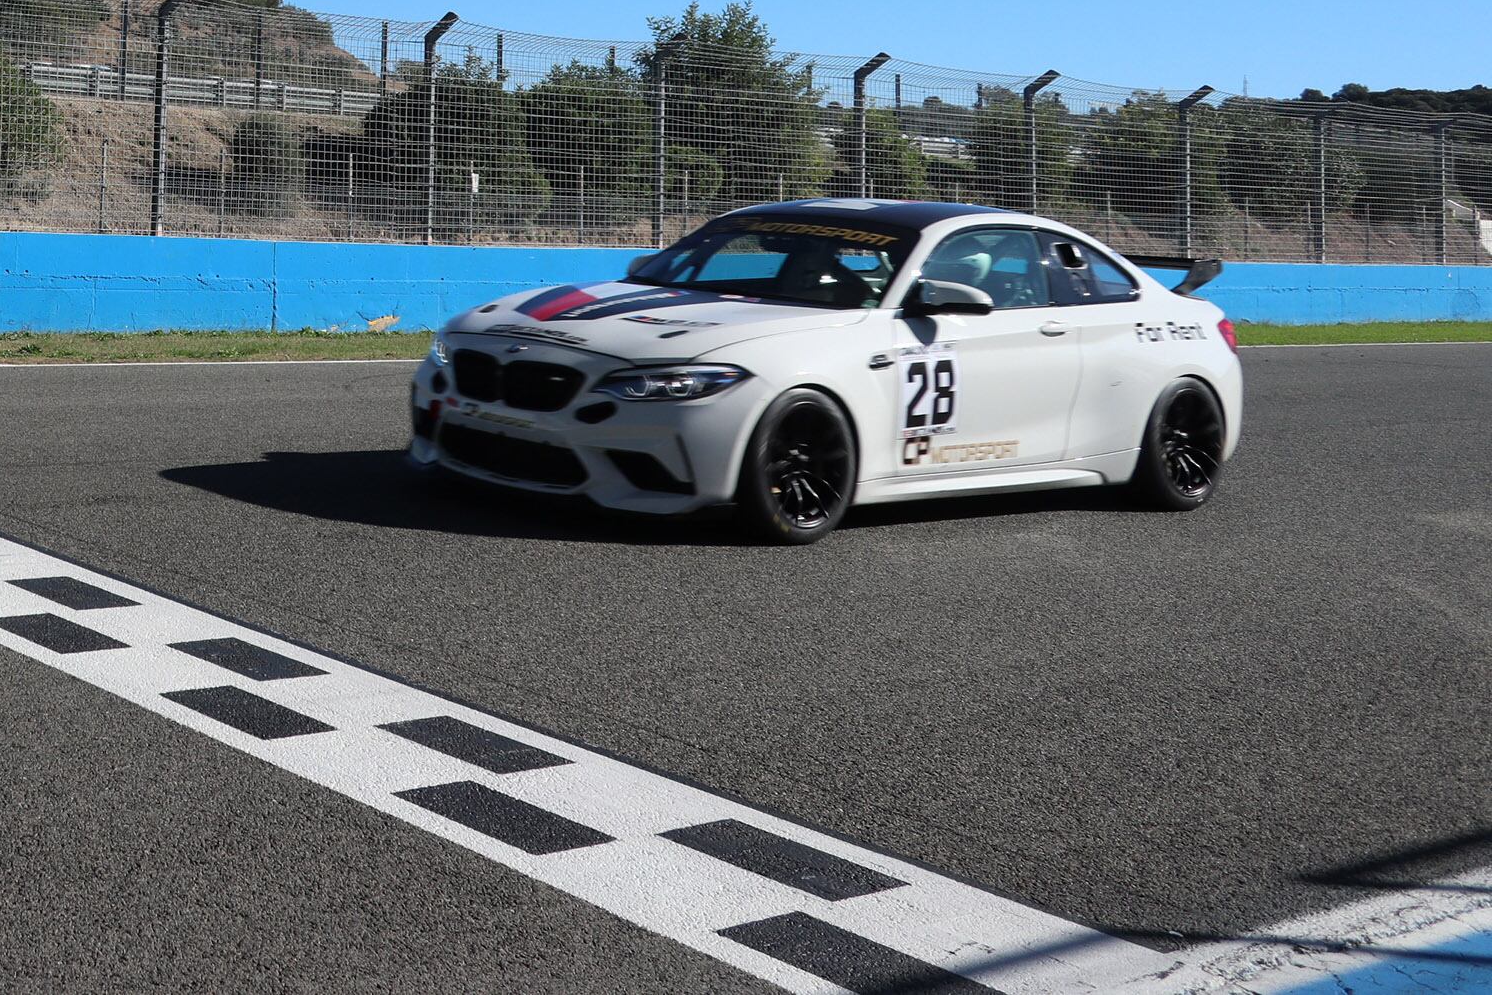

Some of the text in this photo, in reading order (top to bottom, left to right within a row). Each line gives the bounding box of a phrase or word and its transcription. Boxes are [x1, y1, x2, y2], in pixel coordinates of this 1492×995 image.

[748, 221, 900, 246] MOTORSPORT
[1135, 321, 1207, 343] For Rent
[906, 359, 956, 428] 28
[903, 436, 1020, 464] CP MOTORSPORT
